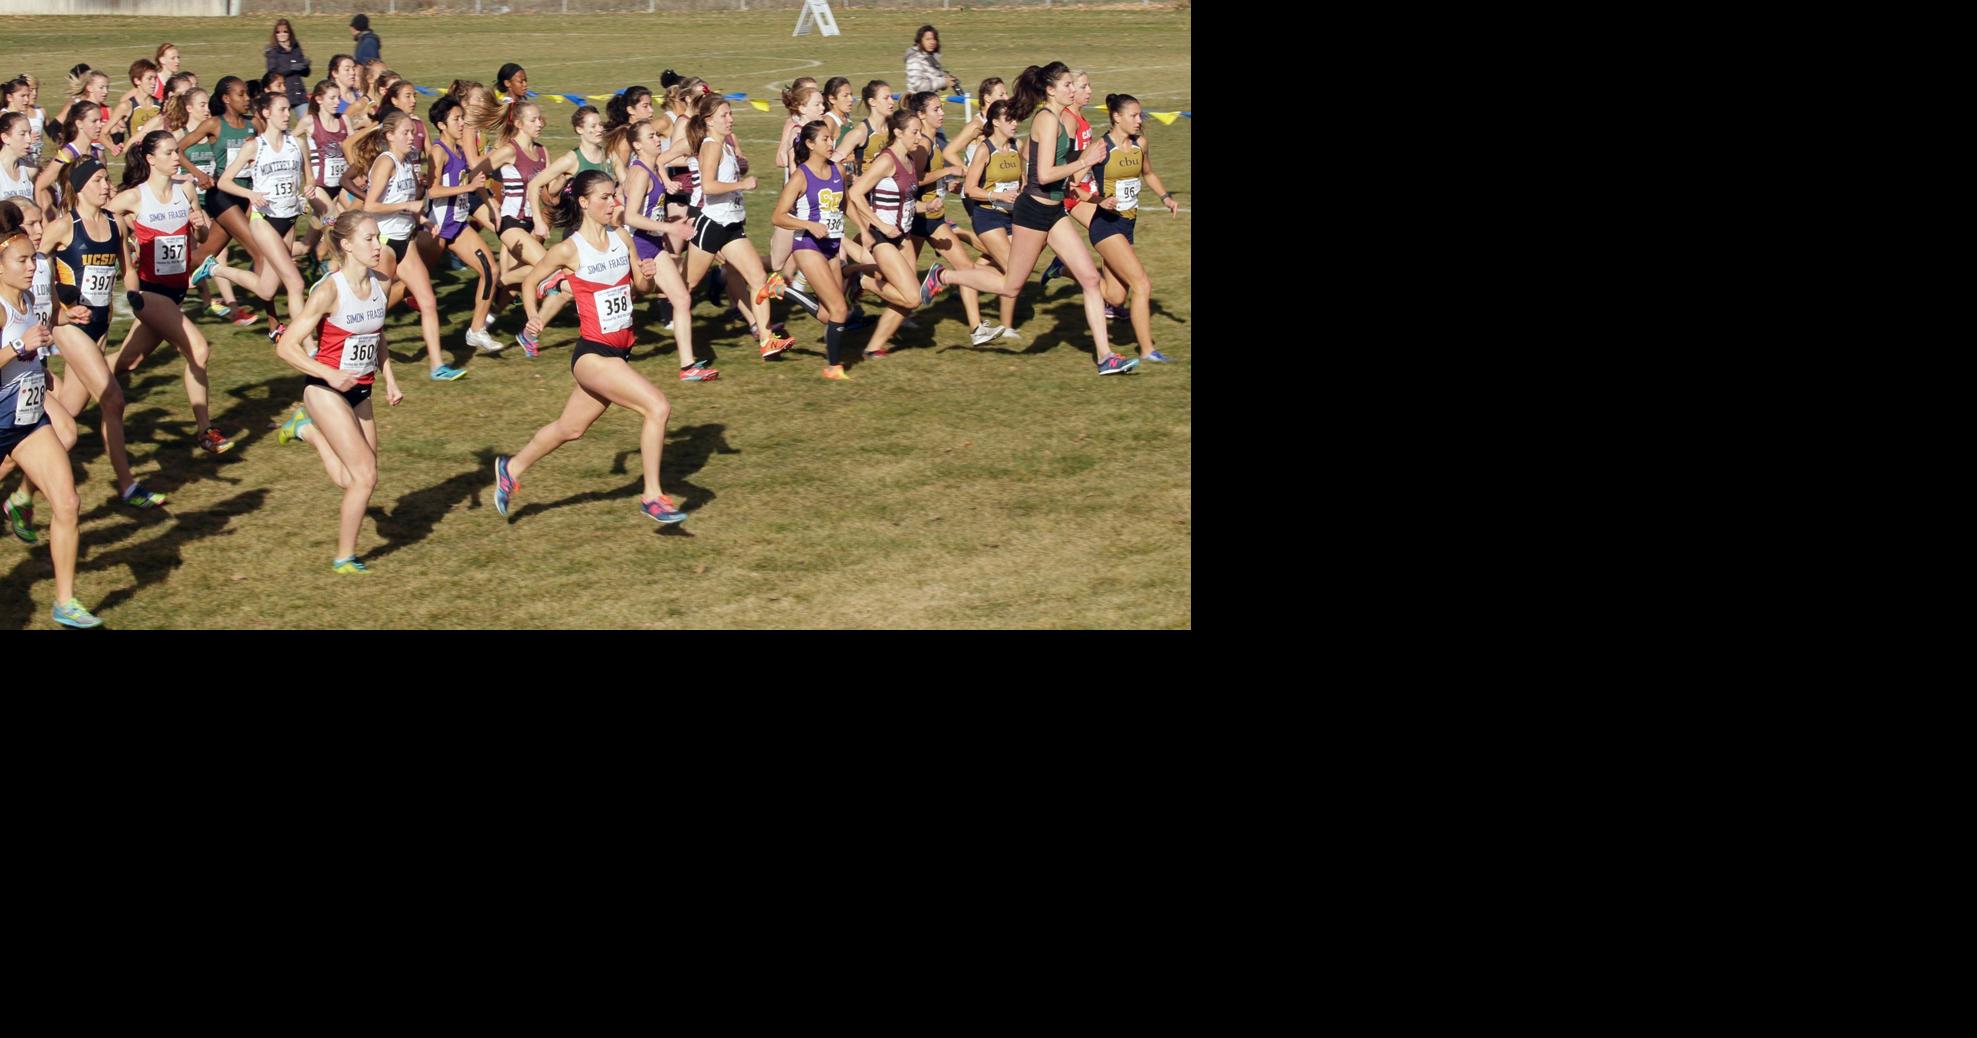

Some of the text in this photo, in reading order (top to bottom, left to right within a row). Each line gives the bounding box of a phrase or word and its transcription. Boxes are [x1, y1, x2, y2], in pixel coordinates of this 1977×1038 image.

[1000, 161, 1017, 170] cbu
[1119, 157, 1139, 168] cbu
[275, 182, 293, 195] 153
[1123, 186, 1136, 199] 96
[162, 244, 184, 260] 357
[587, 263, 607, 275] SIMON
[90, 275, 112, 291] 397
[604, 295, 628, 316] 358
[346, 312, 365, 325] SIMON
[350, 344, 375, 361] 360
